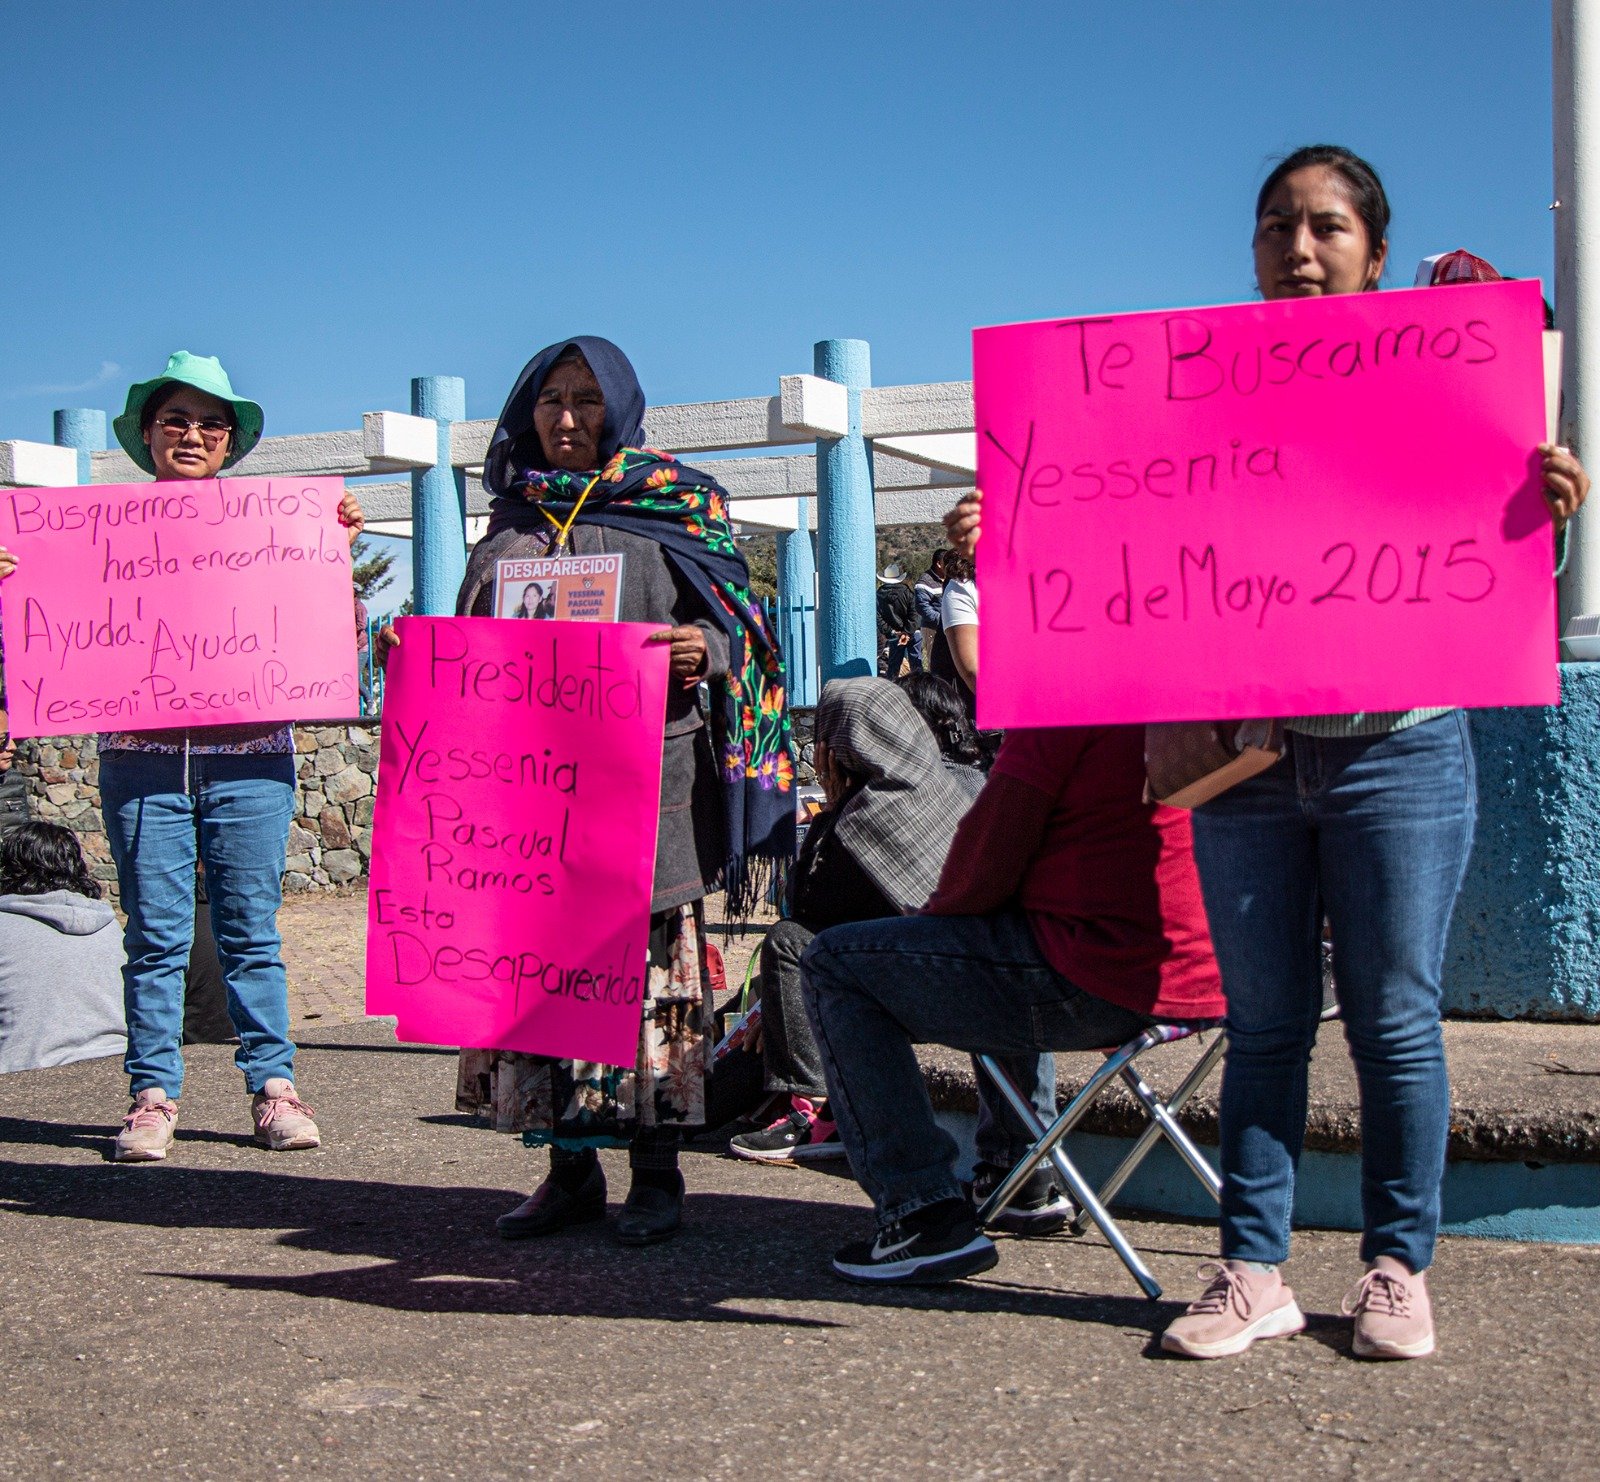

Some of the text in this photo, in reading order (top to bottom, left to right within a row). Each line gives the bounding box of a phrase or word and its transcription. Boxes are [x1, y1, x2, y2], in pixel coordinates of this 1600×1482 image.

[1057, 316, 1498, 400] Te Buscamos
[6, 478, 323, 546] Busquemos Juntos
[984, 420, 1284, 560] Yessenia
[103, 525, 346, 583] hasta encontrarla
[503, 558, 616, 579] DESAPARECIDO
[1028, 538, 1497, 633] 12 de Mayo 2015
[24, 596, 279, 675] Ayuda! Ayuda!
[570, 608, 600, 616] RAMOS
[21, 659, 355, 726] Yesseni Pascual Ramos
[427, 621, 643, 722] Presidenta
[394, 720, 579, 797] Yessenia
[420, 793, 569, 864] Pascual
[420, 841, 556, 896] Ramos
[387, 930, 642, 1018] Desaparecida
